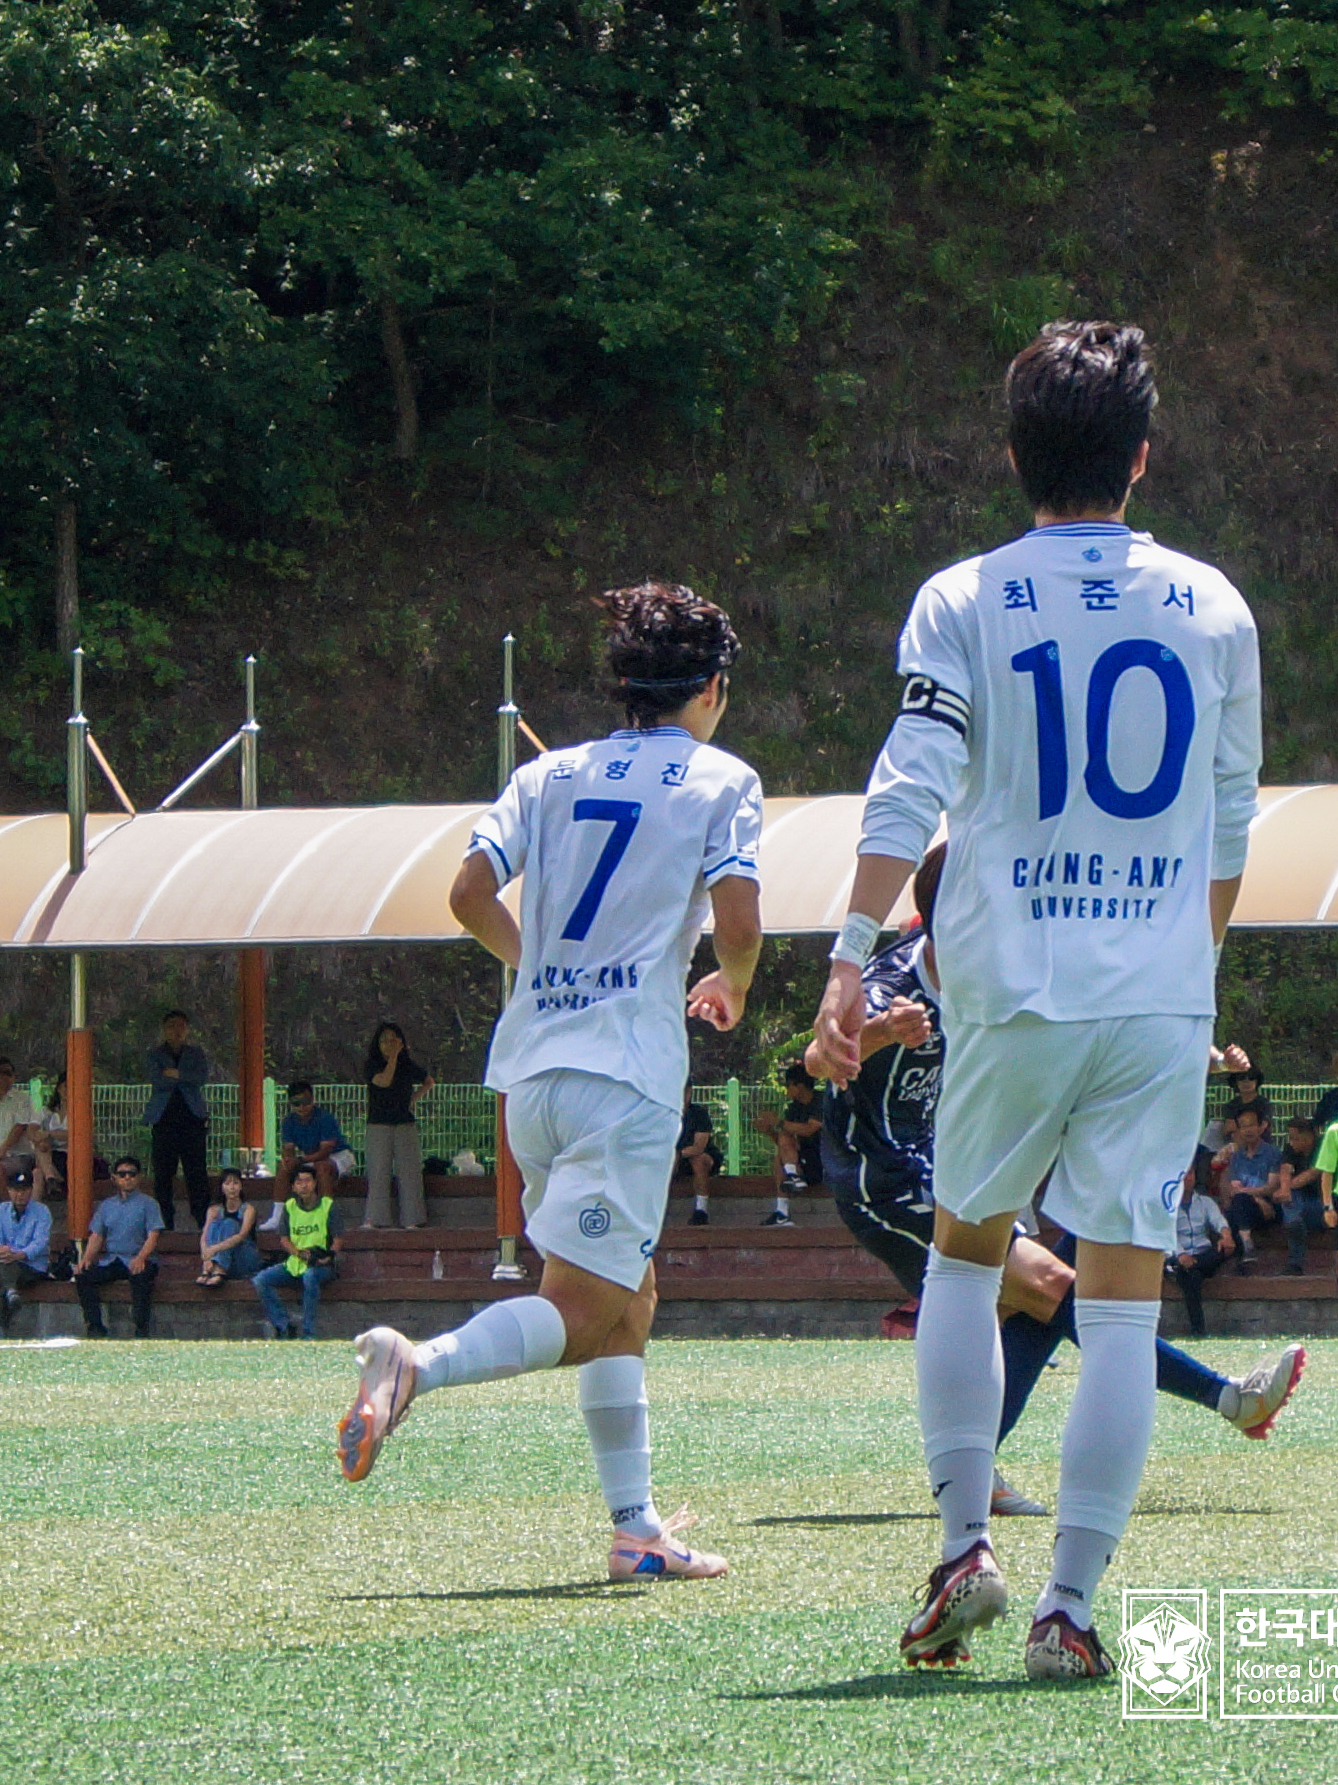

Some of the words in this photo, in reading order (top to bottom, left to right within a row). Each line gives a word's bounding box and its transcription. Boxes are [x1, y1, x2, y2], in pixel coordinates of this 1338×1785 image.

[902, 675, 933, 710] C
[1011, 638, 1196, 821] 10
[559, 798, 643, 941] 7
